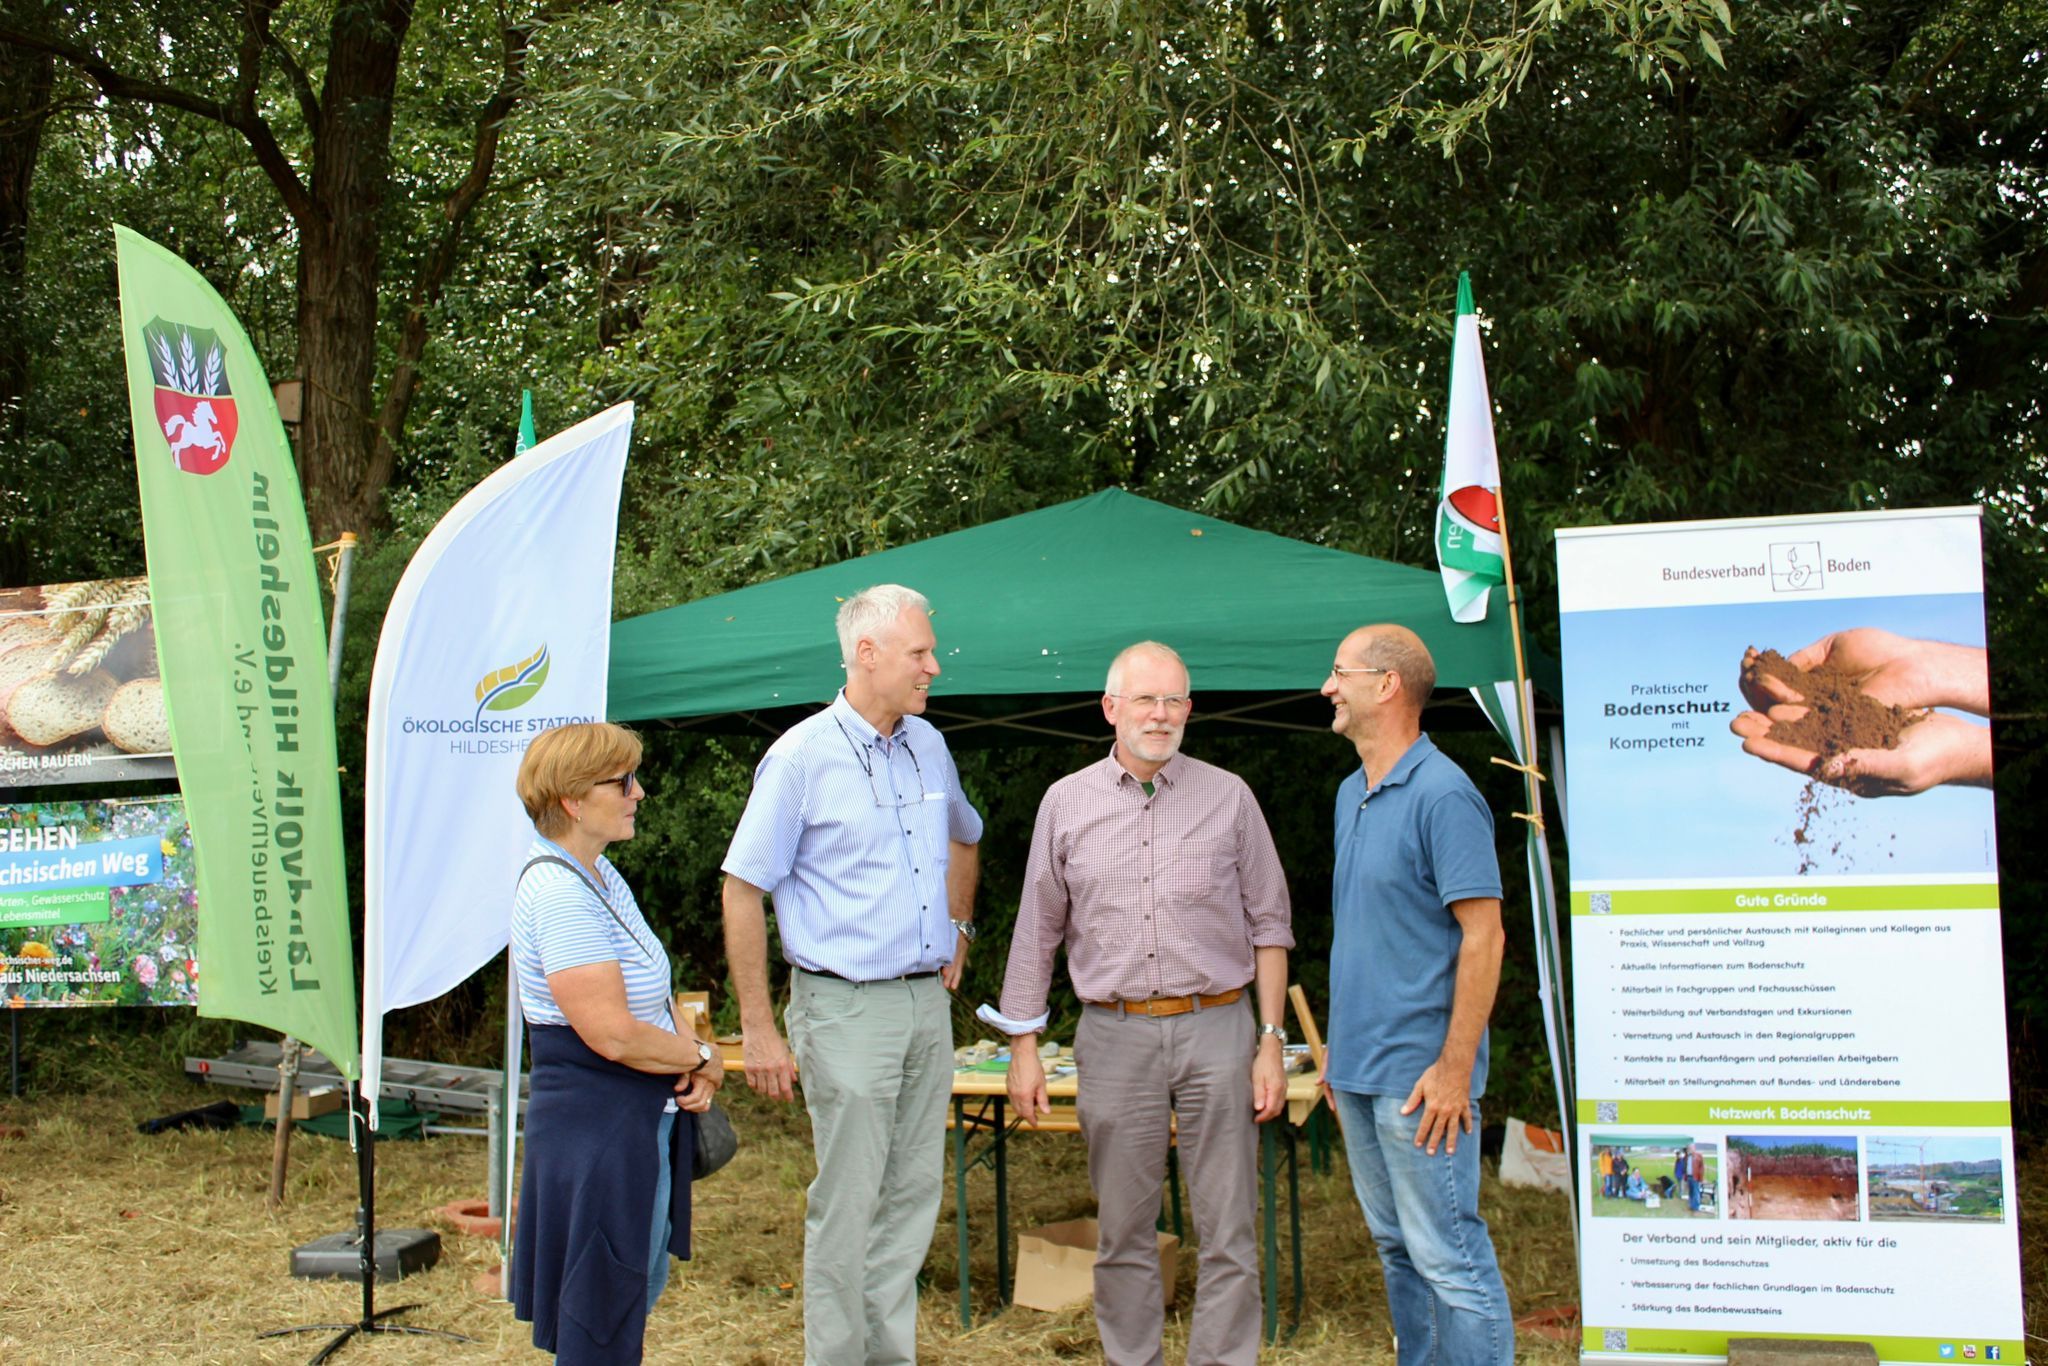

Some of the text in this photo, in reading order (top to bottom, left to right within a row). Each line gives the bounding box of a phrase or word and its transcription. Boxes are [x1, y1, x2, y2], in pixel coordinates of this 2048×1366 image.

[1662, 558, 1871, 582] Bundesverband Boden
[1631, 682, 1709, 696] Praktischer
[1604, 700, 1731, 717] Bodenschutz
[402, 716, 523, 733] ÖKOLOGISCHE
[1671, 720, 1690, 730] mit
[450, 737, 530, 755] HILDESHE
[1609, 736, 1705, 752] Kompetenz
[41, 753, 92, 769] BAUERN
[102, 850, 149, 876] Weg
[31, 891, 106, 907] Gewässerschutz
[1735, 893, 1828, 907] Gute Gründe
[1620, 928, 1664, 937] Fachlicher
[1667, 928, 1685, 936] und
[1687, 927, 1742, 939] persönlicher
[1746, 926, 1791, 935] Austausch
[1794, 926, 1809, 934] mit
[1812, 925, 1867, 936] Kolleginnen
[1870, 924, 1888, 933] und
[1891, 924, 1932, 935] Kollegen
[1620, 938, 1765, 949] Praxis, Wissenschaft und Vollzug
[1621, 960, 1805, 971] Aktuelle Informationen zum Bodenschutz
[0, 967, 121, 983] aus Niedersachsen
[1622, 983, 1836, 996] Mitarbeit in Fachgruppen und Fachausschüssen
[1622, 1007, 1852, 1019] Weiterbildung auf Verbandstagen und Exkursionen
[1623, 1030, 1856, 1042] Vernetzung und Austausch in den Regionalgruppen
[1624, 1054, 1664, 1063] Kontakte
[1679, 1054, 1756, 1065] Berufsanfängern
[1758, 1054, 1776, 1063] und
[1778, 1054, 1835, 1065] potenziellen
[1837, 1054, 1899, 1065] Arbeitgebern
[1624, 1077, 1666, 1086] Mitarbeit
[1683, 1077, 1757, 1088] Stellungnahmen
[1759, 1077, 1775, 1086] auf
[1778, 1077, 1816, 1086] Bundes-
[1818, 1077, 1837, 1086] und
[1839, 1077, 1901, 1087] Länderebene
[1709, 1107, 1871, 1120] Netzwerk Bodenschutz
[1622, 1233, 1897, 1248] Der Verband und sein Mitglieder, aktiv für die
[1630, 1257, 1769, 1268] Umsetzung des Bodenschutzes
[1631, 1280, 1895, 1295] Verbesserung der fachlichen Grundlagen im Bodenschutz
[1632, 1303, 1782, 1315] Stärkung des Bodenbewusstseins
